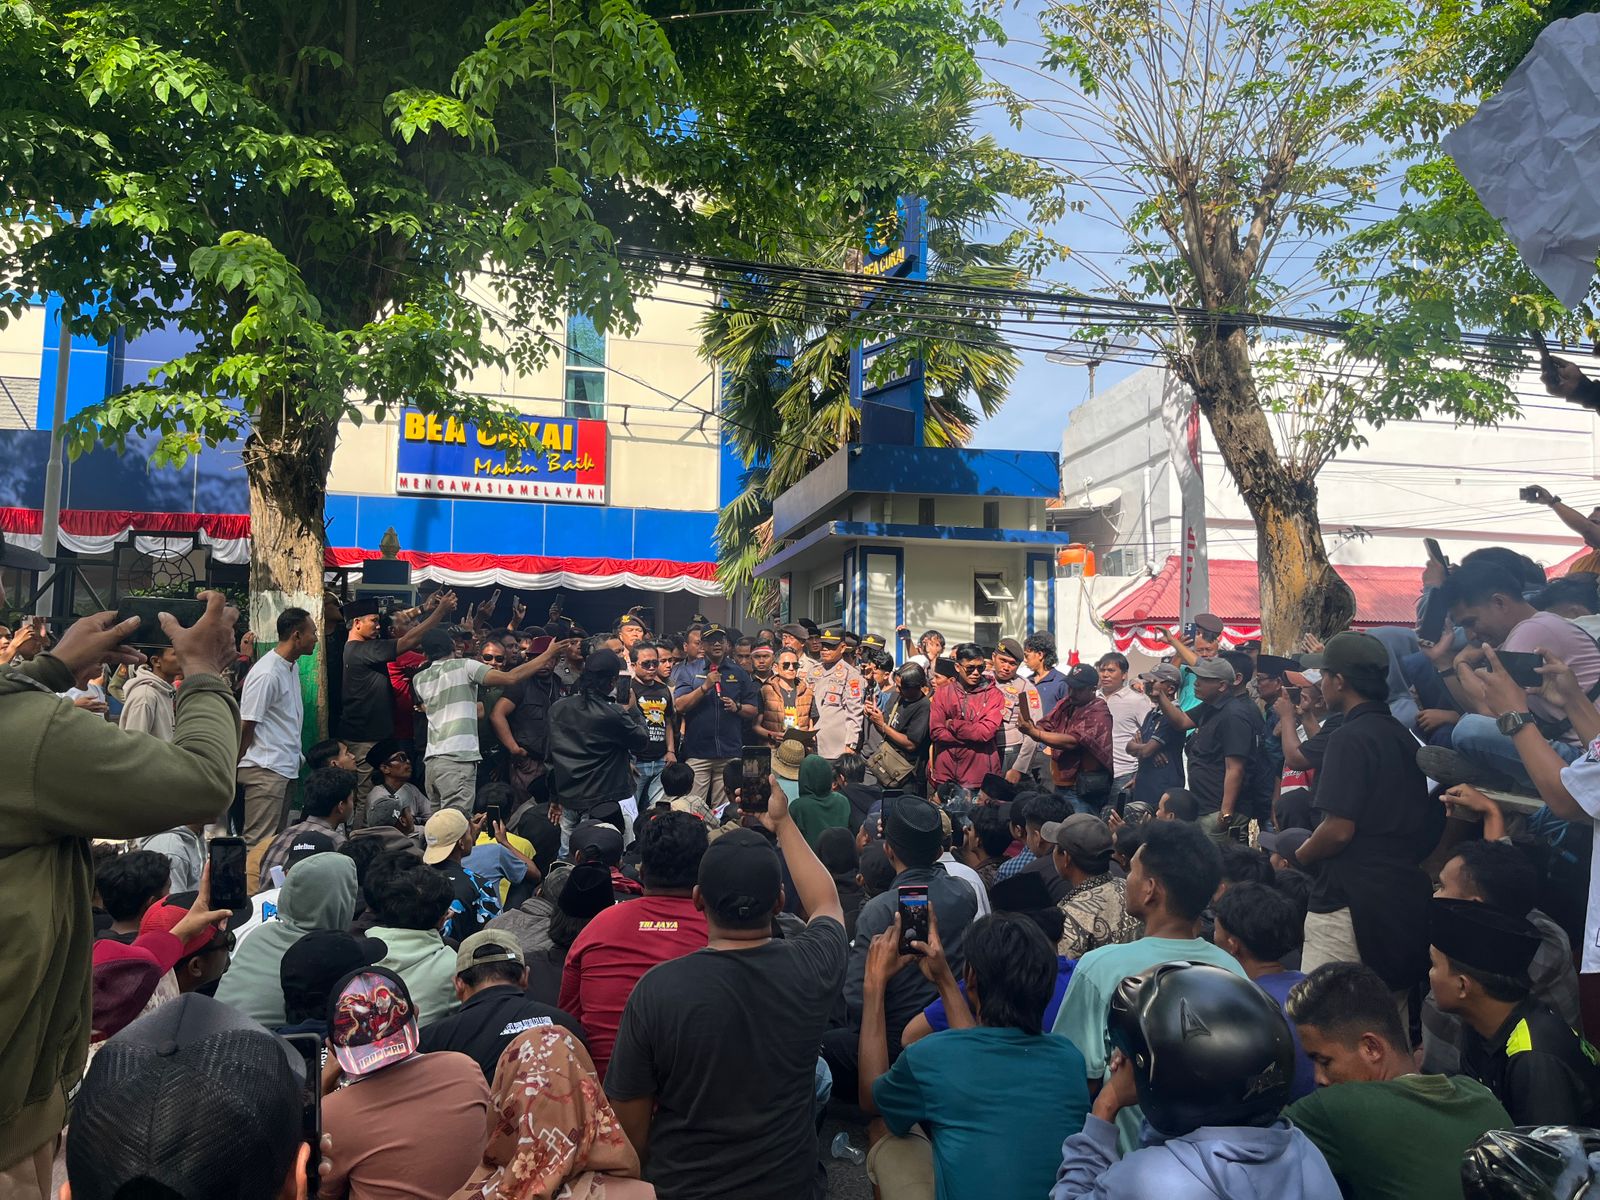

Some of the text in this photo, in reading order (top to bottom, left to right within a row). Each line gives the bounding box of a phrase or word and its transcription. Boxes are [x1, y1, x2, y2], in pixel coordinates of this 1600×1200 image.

[404, 412, 467, 443] BEA
[547, 452, 595, 472] Baik
[399, 477, 502, 494] MENGAWASI
[520, 484, 603, 500] MELAYANI
